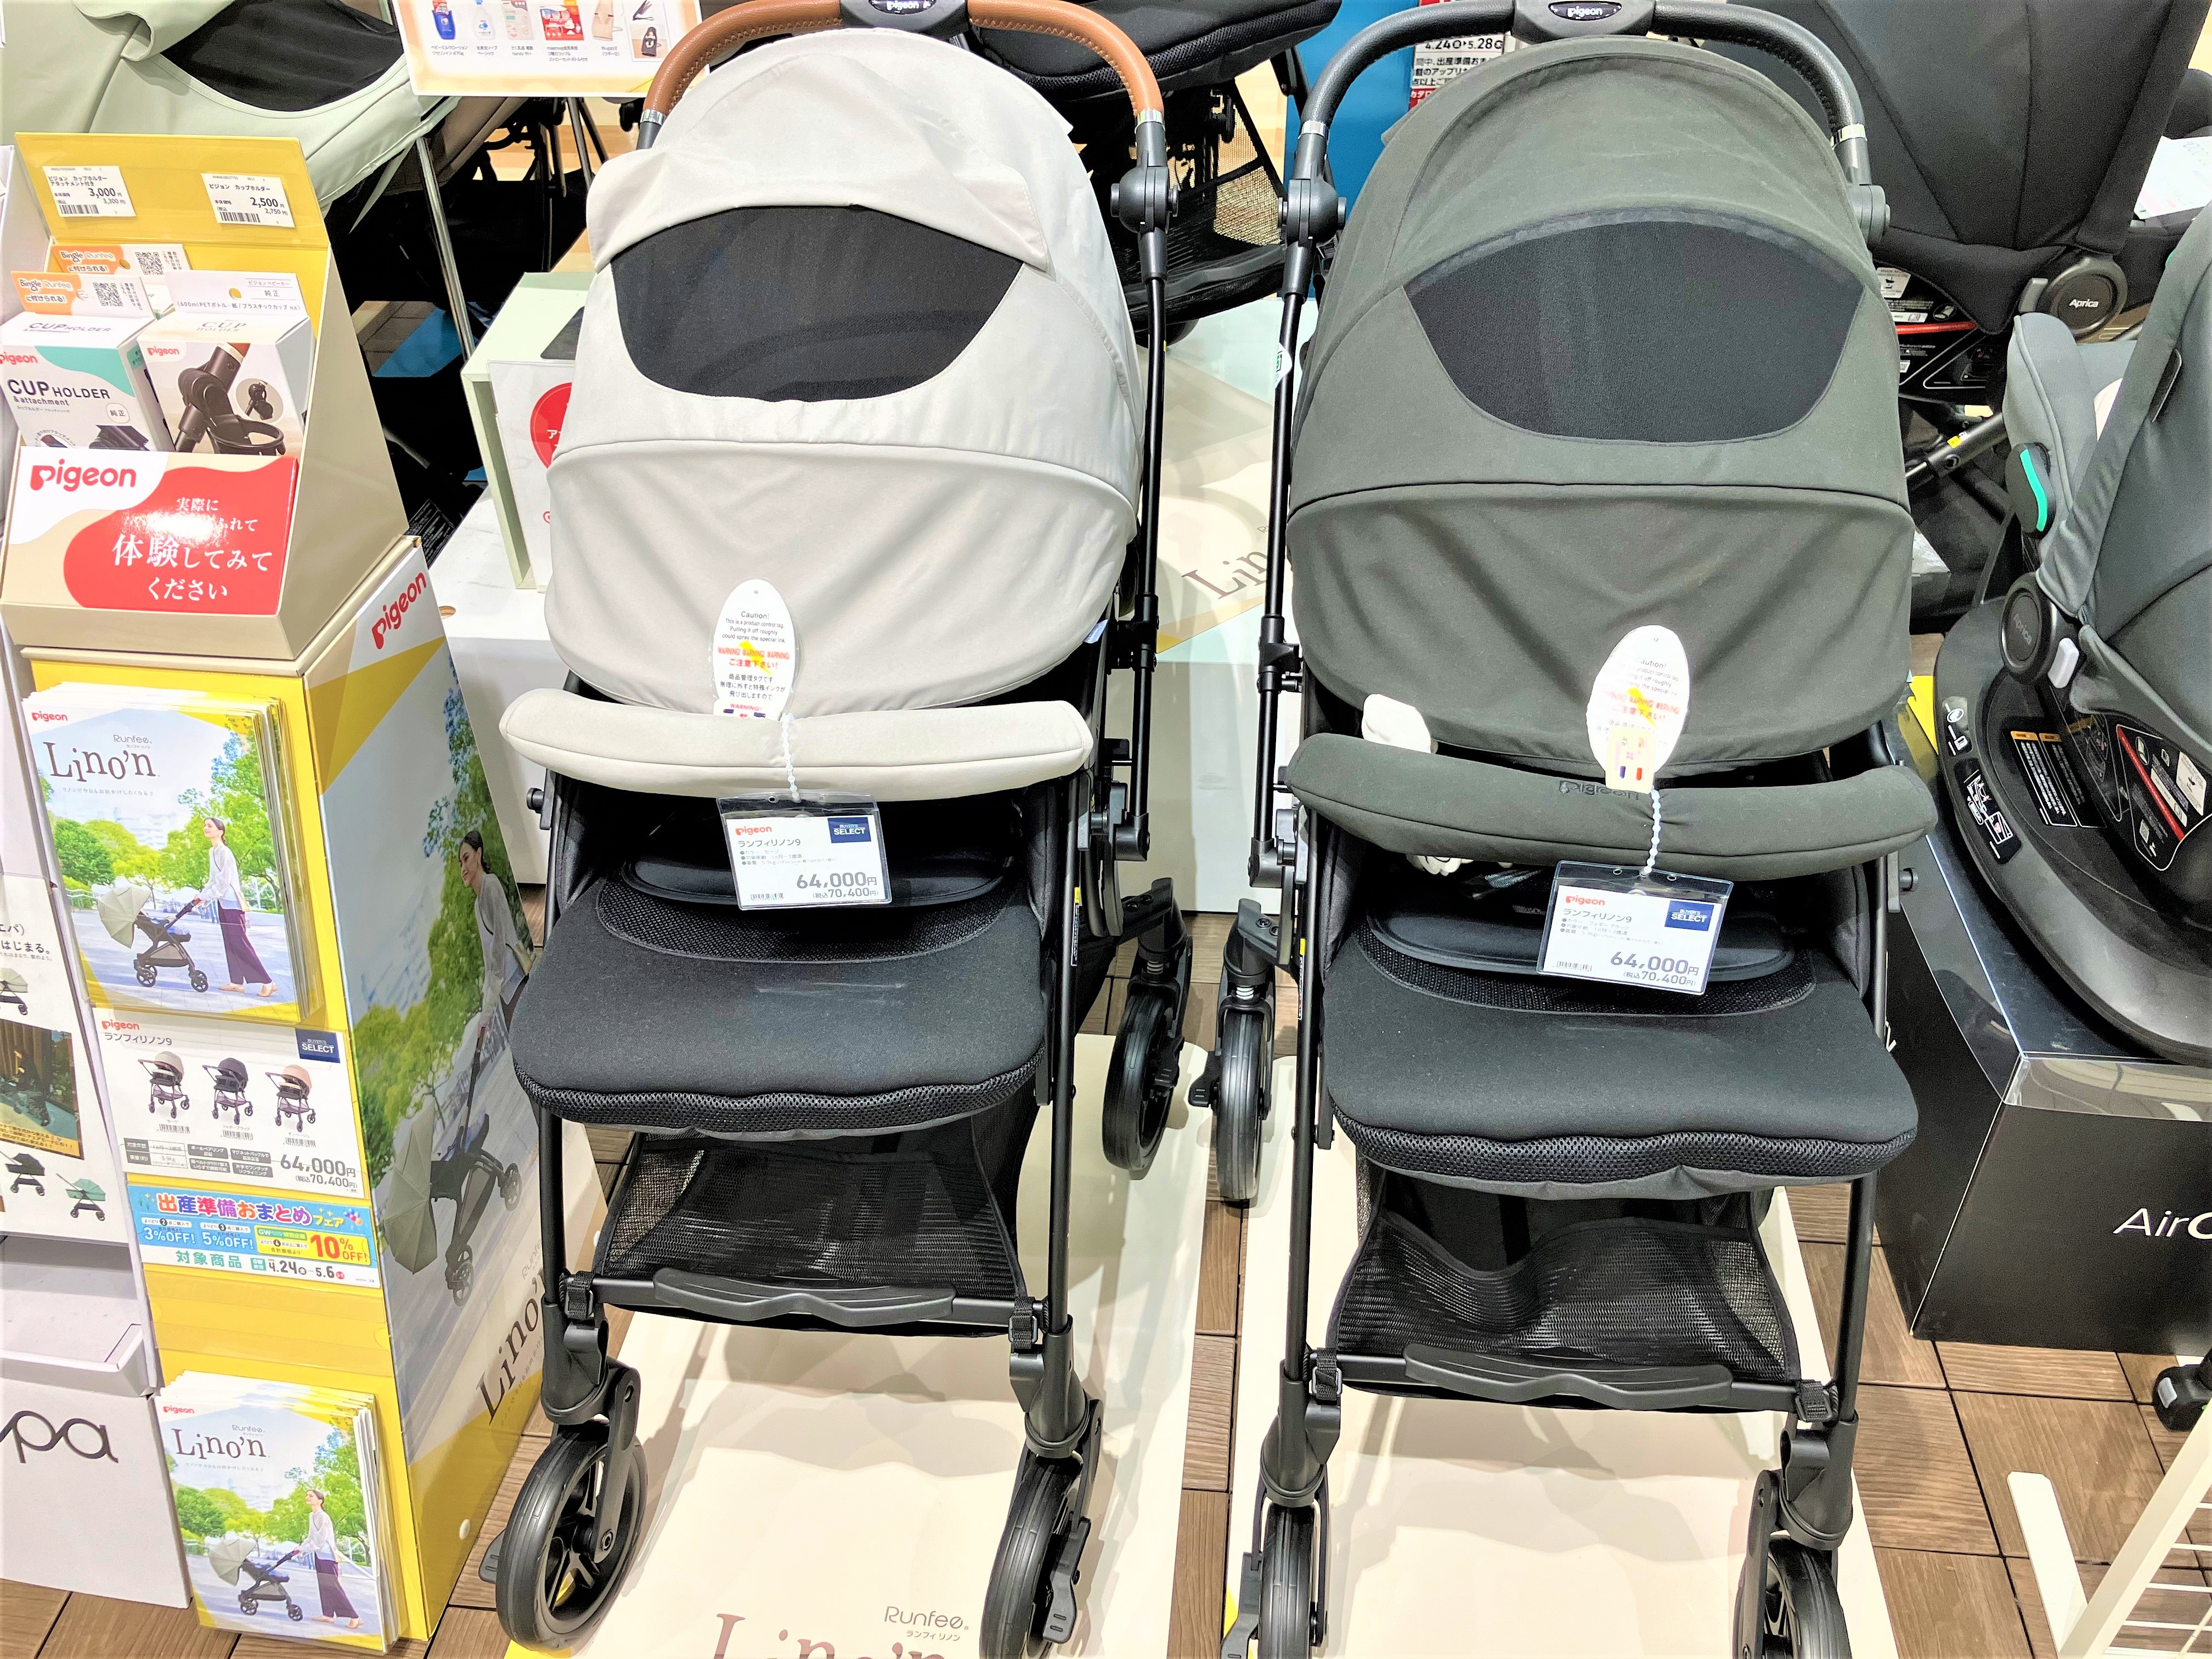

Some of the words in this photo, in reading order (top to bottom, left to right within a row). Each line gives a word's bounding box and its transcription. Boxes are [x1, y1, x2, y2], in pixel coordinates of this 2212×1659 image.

[1567, 5, 1603, 18] pigeon
[2069, 298, 2099, 308] Aprica
[147, 346, 180, 356] pigeon
[7, 379, 50, 397] CUP
[53, 386, 111, 399] HOLDER
[30, 459, 137, 492] pigeon
[176, 497, 219, 512] 実際に
[112, 533, 273, 571] 体験してみて
[148, 577, 228, 601] ください
[371, 572, 427, 650] pigeon
[741, 611, 770, 619] Caution!
[718, 646, 740, 656] WARNING!
[742, 648, 765, 658] WARNING!
[767, 651, 790, 660] WARNING!
[729, 658, 778, 669] ご注意下さい!
[31, 712, 68, 722] pigeon
[113, 734, 149, 744] Runfee
[43, 742, 156, 782] Lino'n
[735, 825, 772, 836] pigeon
[833, 827, 866, 836] SELECT
[738, 839, 801, 848] ランフィリノン9
[797, 871, 878, 889] 64,000円
[1565, 895, 1605, 906] pigeon
[1563, 907, 1632, 923] ランフィリノン9
[1671, 912, 1707, 923] SELECT
[1, 940, 50, 955] はじまる。
[1610, 951, 1700, 976] 64,000円
[101, 1019, 140, 1030] pigeon
[104, 1032, 172, 1046] ランフィリノン9
[302, 1043, 335, 1054] SELECT
[280, 1154, 356, 1178] 64,000円
[143, 1227, 196, 1244] 3%OFF!
[202, 1232, 255, 1249] 5%OFF!
[176, 1250, 242, 1269] 対象商品
[163, 1406, 194, 1414] pigeon
[232, 1425, 263, 1433] Runfee
[171, 1429, 267, 1460] Lino'n
[884, 1606, 963, 1629] Runfee
